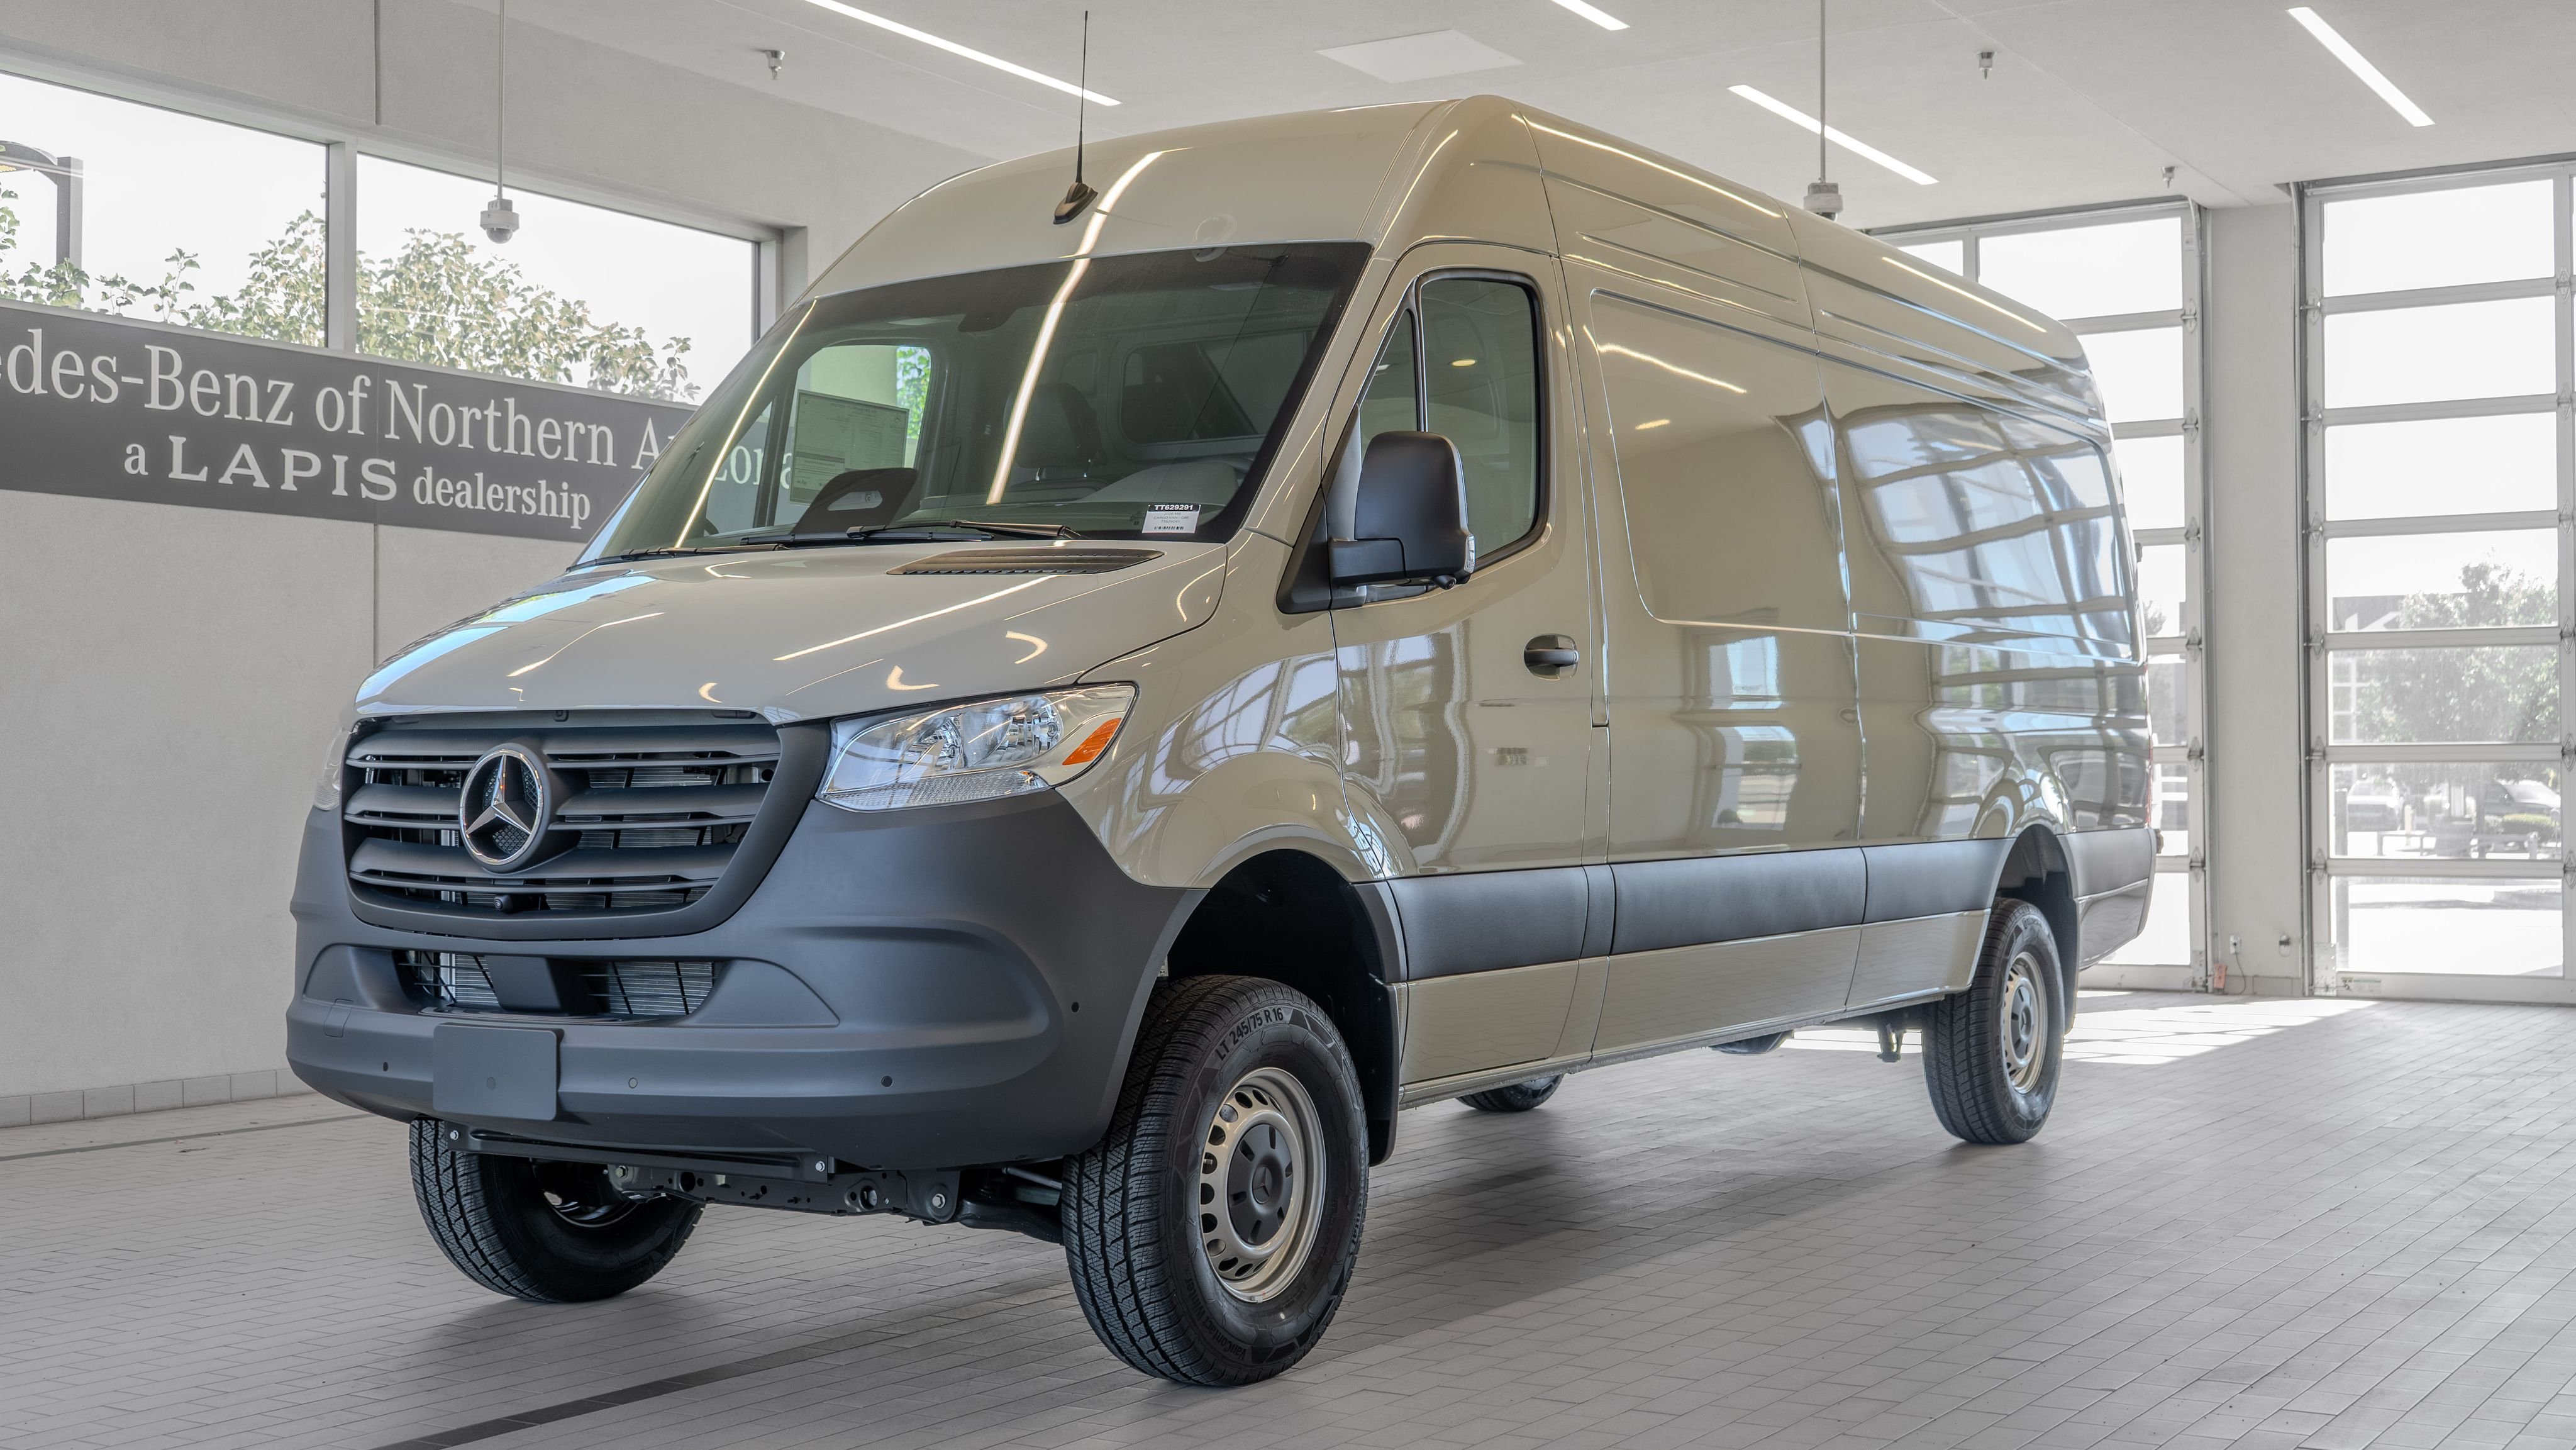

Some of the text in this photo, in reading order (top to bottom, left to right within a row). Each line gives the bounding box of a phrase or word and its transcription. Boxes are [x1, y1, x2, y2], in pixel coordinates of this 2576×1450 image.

[0, 328, 295, 427] des-Benz
[315, 374, 371, 435] of
[384, 379, 617, 467] Northern
[124, 435, 591, 530] a LAPIS dealership
[1215, 1007, 1284, 1061] LT 245/75 R 16
